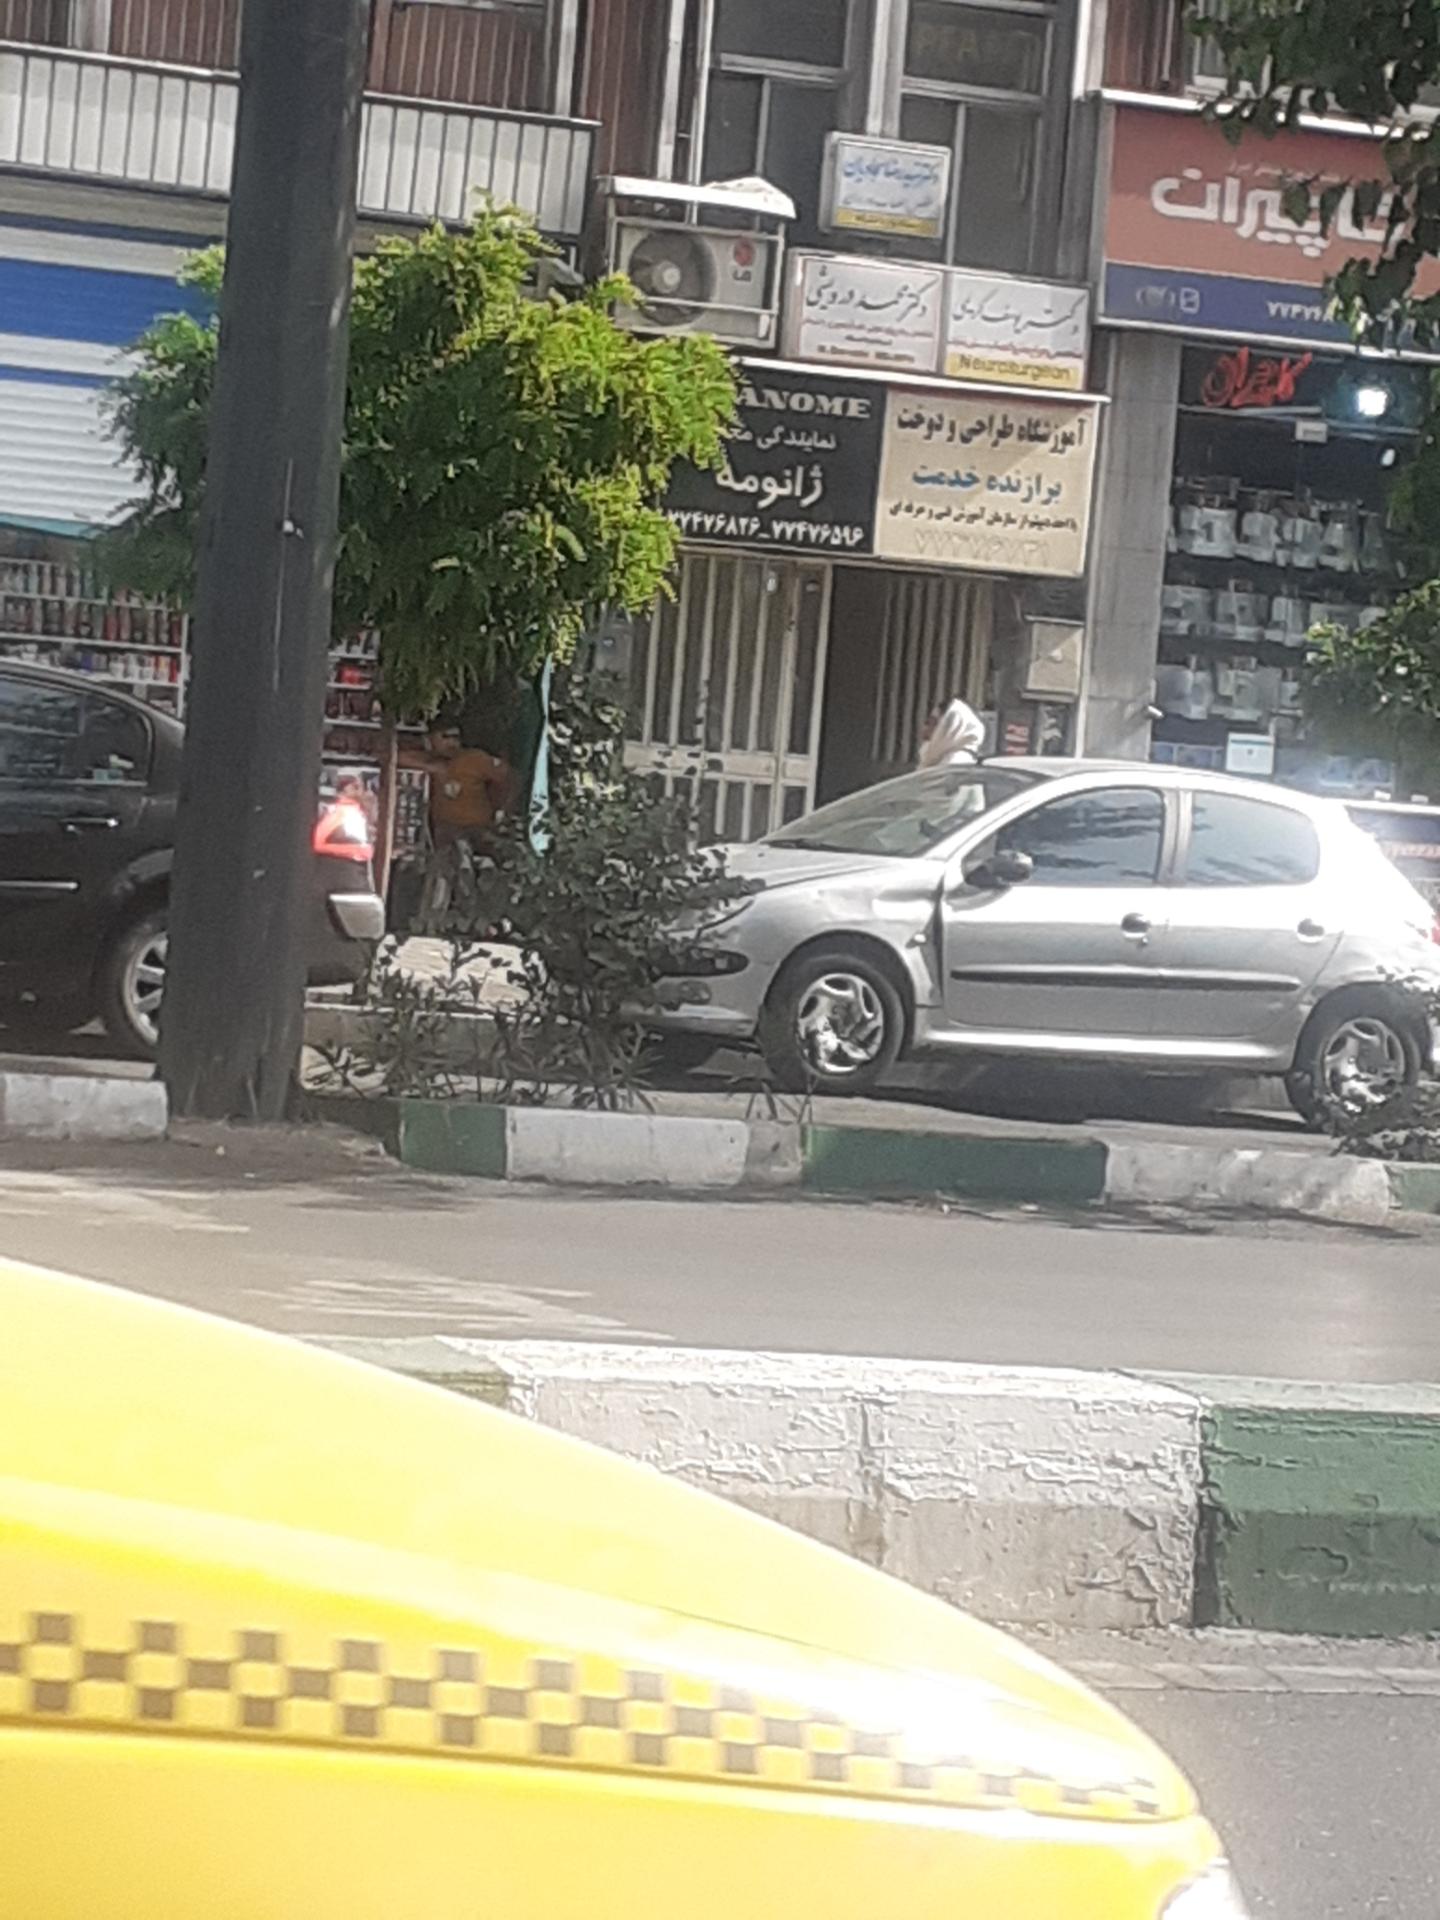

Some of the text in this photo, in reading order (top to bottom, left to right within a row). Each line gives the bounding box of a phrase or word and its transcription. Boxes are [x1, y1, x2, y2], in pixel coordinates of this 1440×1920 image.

[896, 275, 940, 322] دکتر
[735, 386, 872, 419] ANOME
[756, 425, 837, 452] نمایندگی
[897, 404, 1087, 454] آموزشگاه طراحی و دوخت
[715, 463, 824, 509] ژانومه
[912, 465, 1063, 505] برازنده خدمت
